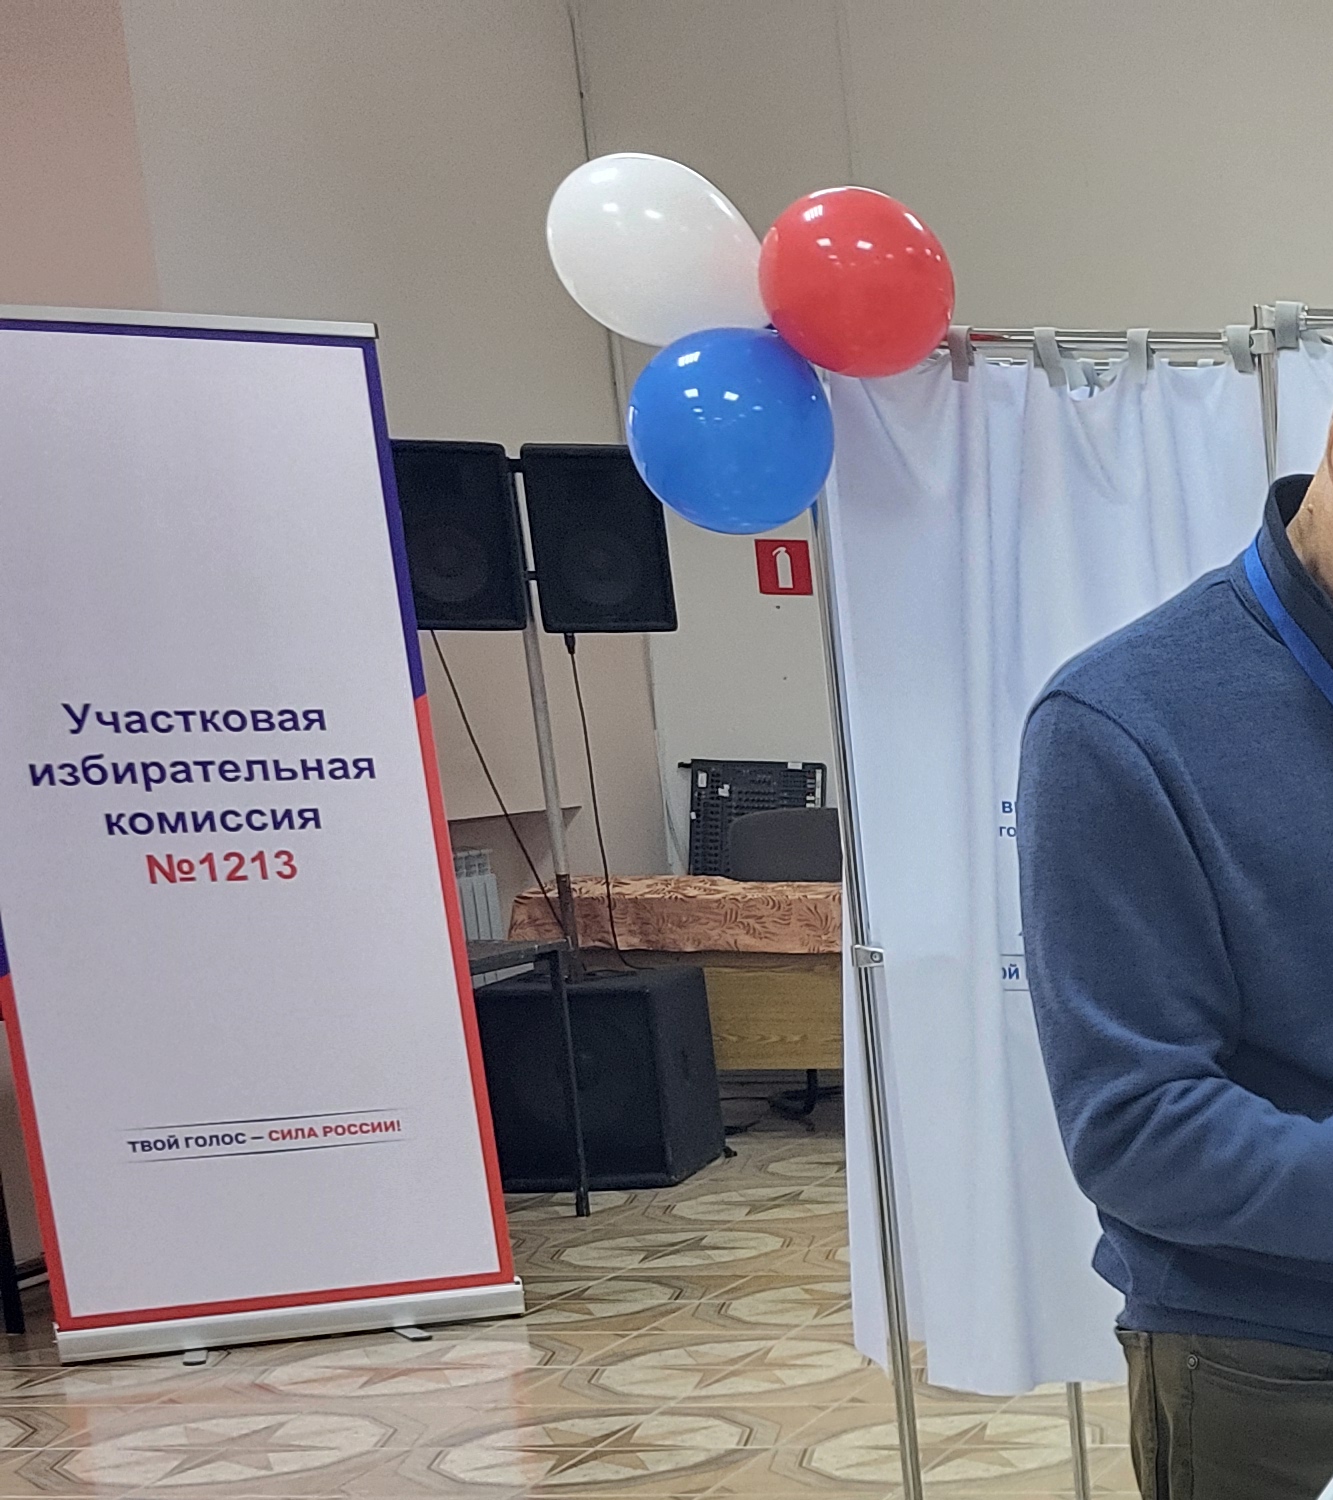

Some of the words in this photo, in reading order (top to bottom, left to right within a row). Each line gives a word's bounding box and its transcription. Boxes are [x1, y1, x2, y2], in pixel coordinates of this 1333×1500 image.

[61, 703, 327, 734] Участковая
[29, 754, 376, 791] избирательная
[105, 808, 321, 835] комиссия
[146, 850, 298, 884] №1213
[128, 1135, 180, 1153] ТВОЙ
[184, 1132, 247, 1149] ГОЛОС
[268, 1126, 319, 1142] СИЛА
[322, 1119, 402, 1137] РОССИИ!
